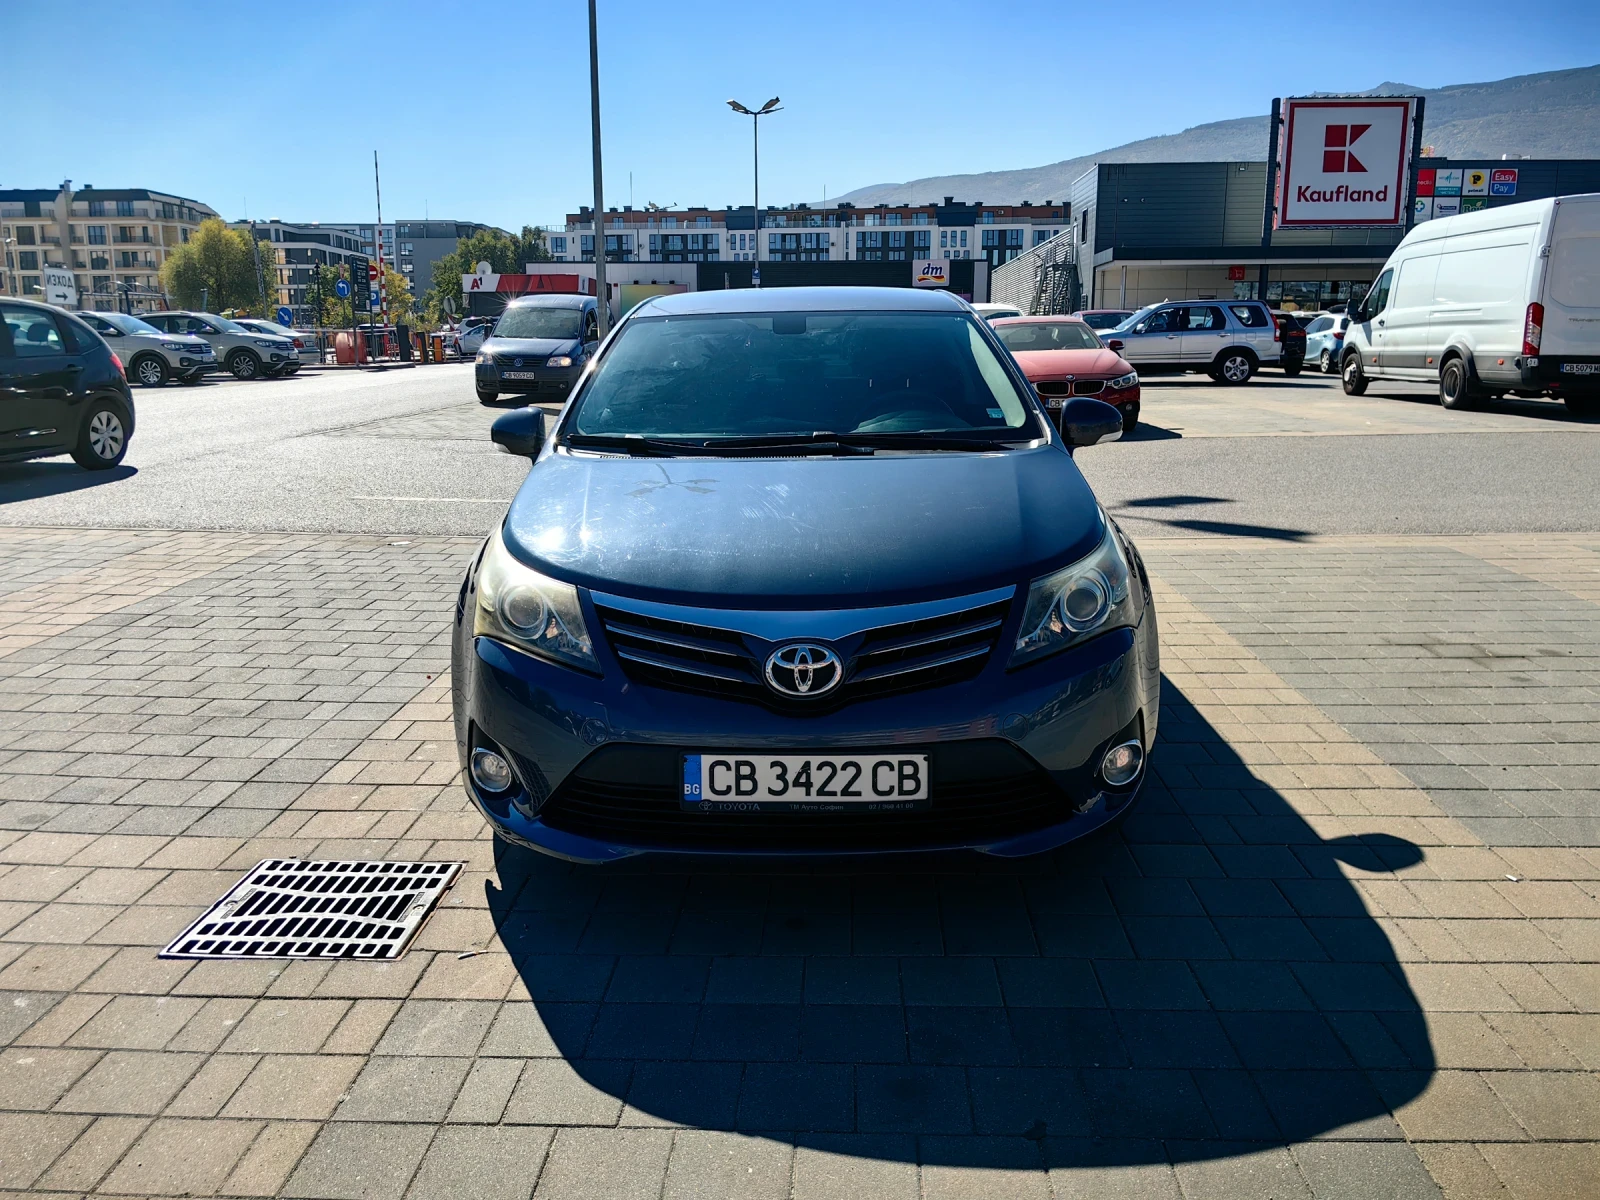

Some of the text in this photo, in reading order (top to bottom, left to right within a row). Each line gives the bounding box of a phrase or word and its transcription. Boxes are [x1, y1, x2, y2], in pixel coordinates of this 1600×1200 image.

[1495, 172, 1514, 182] Easy
[1297, 185, 1388, 203] Kaufland
[1493, 183, 1509, 194] Pay
[922, 262, 943, 276] dm
[46, 273, 74, 289] ИЗХОД
[470, 276, 483, 290] A1
[708, 760, 921, 796] CB 3422 CB
[684, 784, 700, 794] BG
[717, 803, 761, 811] TOYOTA
